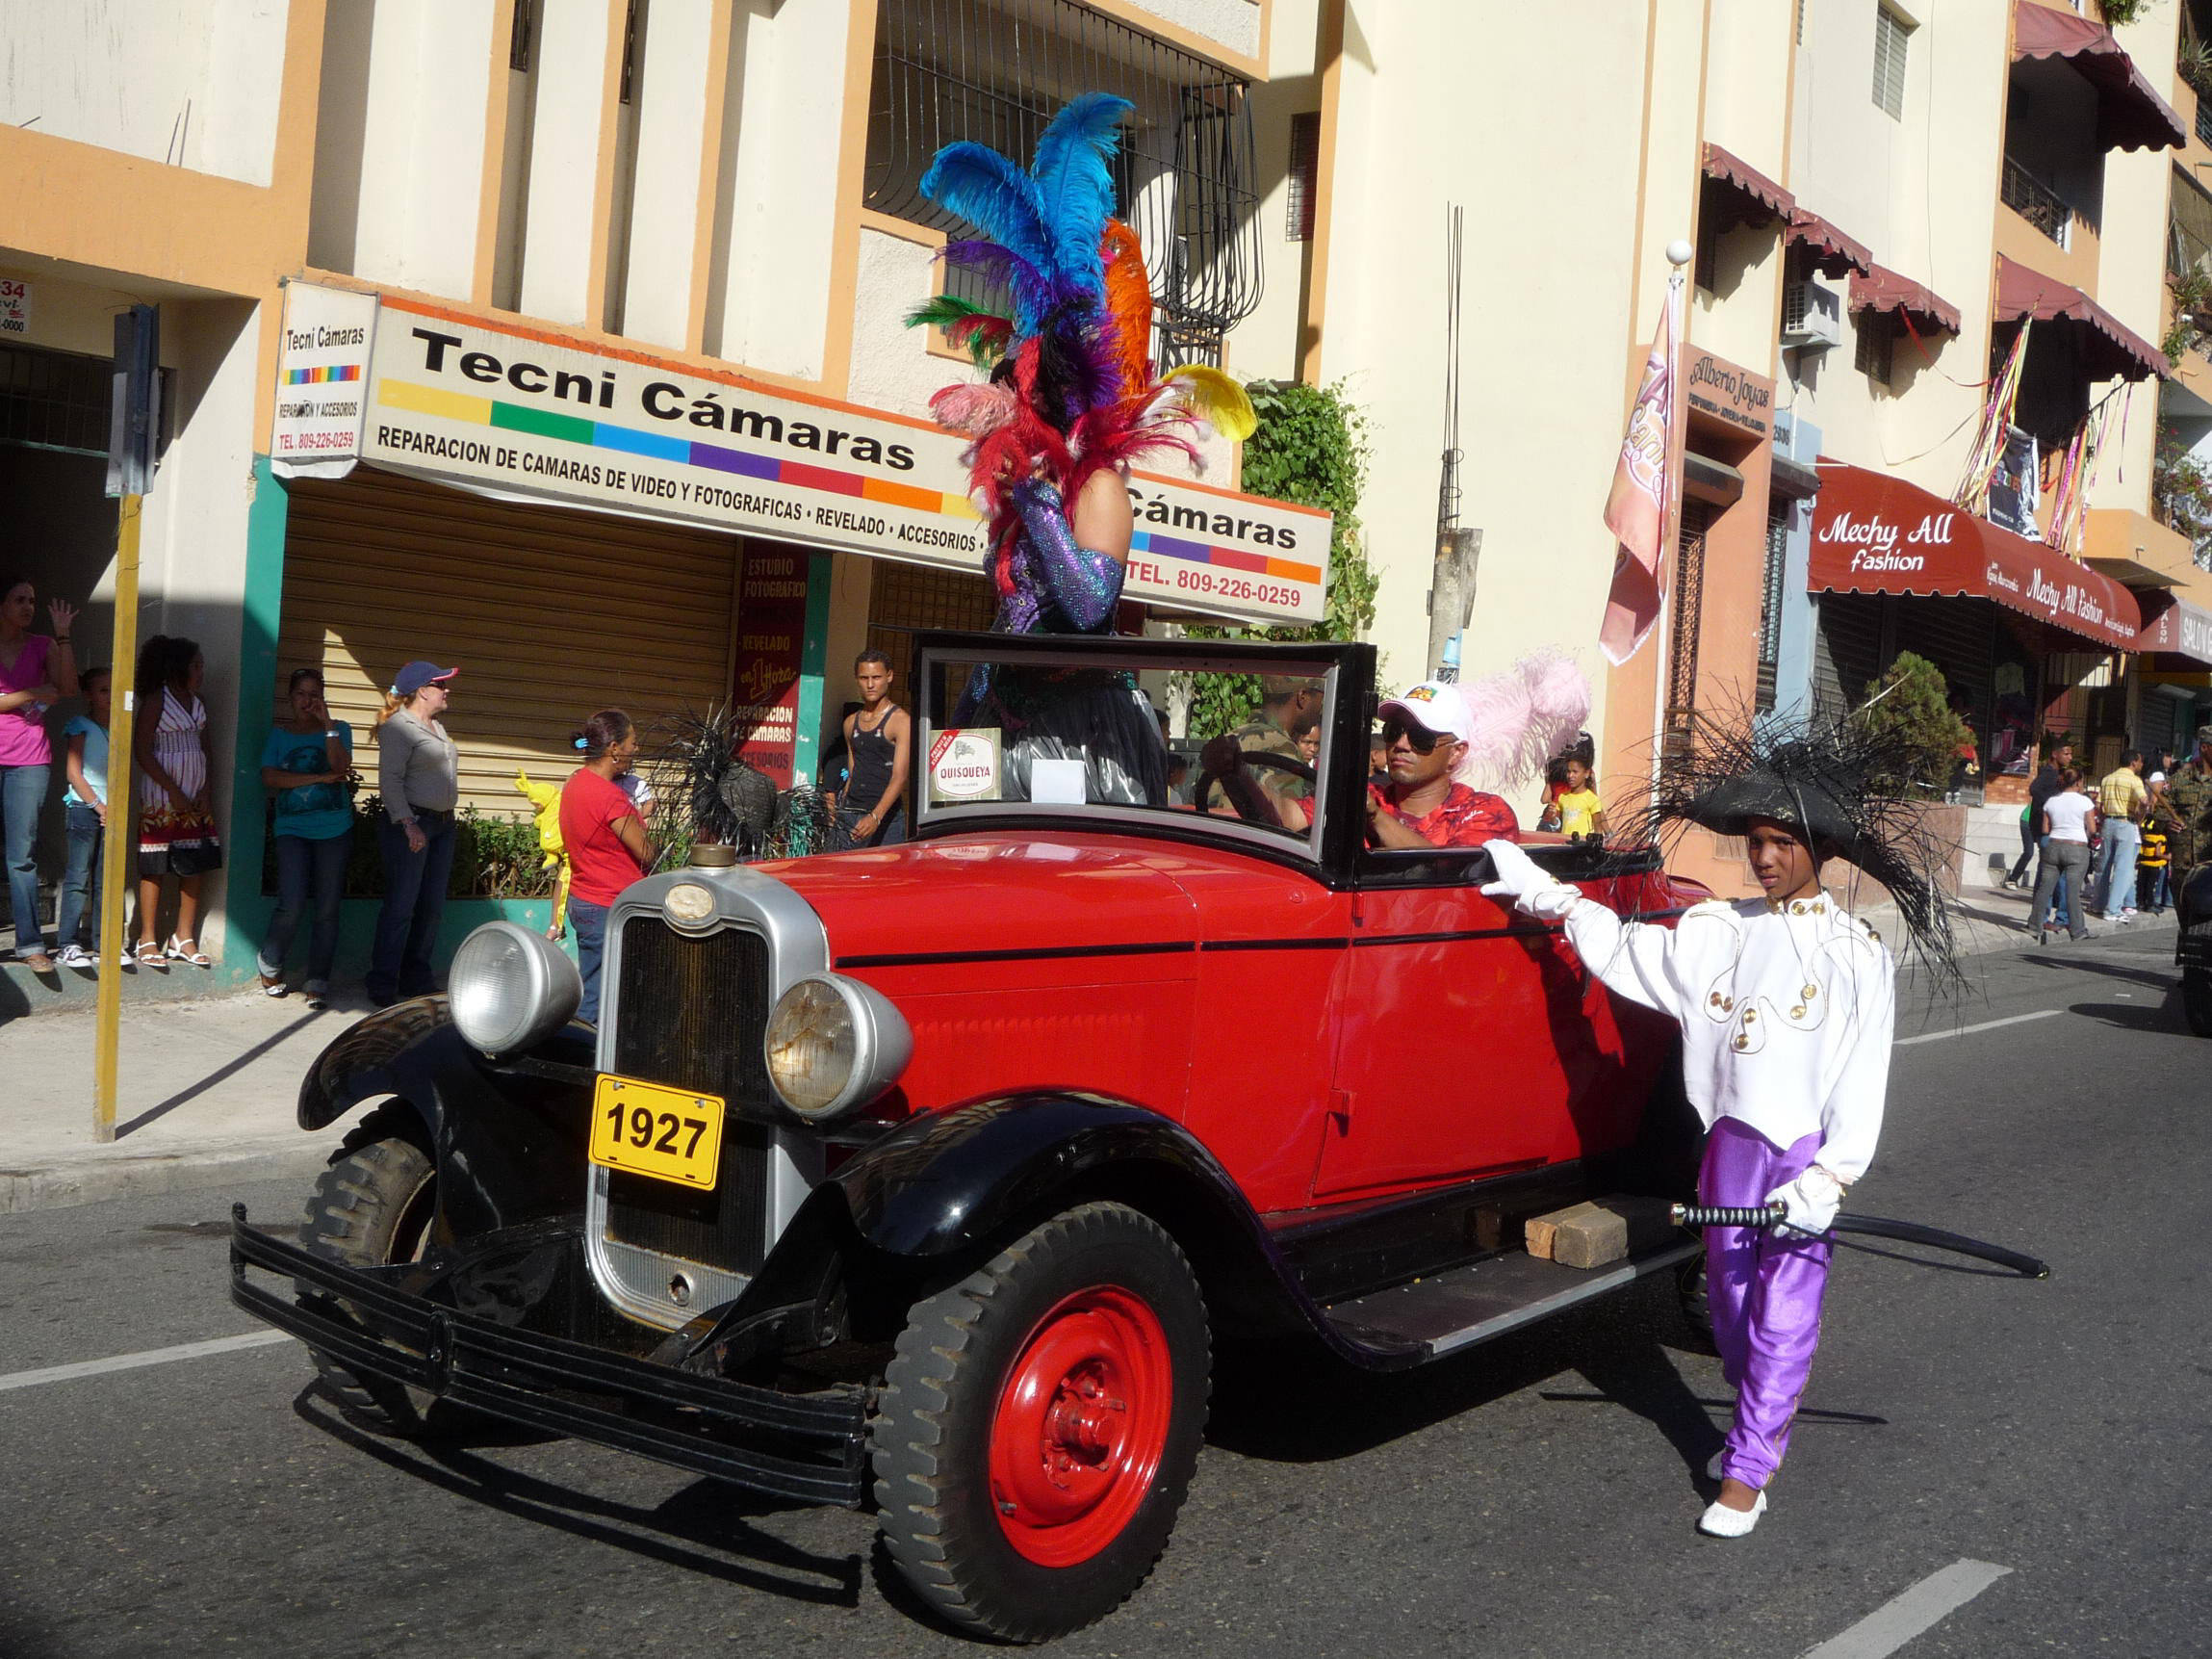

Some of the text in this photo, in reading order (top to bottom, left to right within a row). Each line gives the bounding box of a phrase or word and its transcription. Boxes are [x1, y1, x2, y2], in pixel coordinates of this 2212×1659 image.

[286, 325, 365, 351] Tecni Cámaras
[412, 326, 915, 471] Tecni Cámaras
[1689, 356, 1769, 411] Alberto Joyas
[316, 402, 322, 418] Y
[321, 402, 358, 417] ACCESORIOS
[298, 431, 354, 449] 809-226-0259
[377, 425, 976, 553] REPARACION DE CAMARAS DE VIDEO Y FOTOGRAFICAS REVELADO ACCESORIOS
[1818, 511, 1898, 552] Mechy
[1908, 513, 1955, 544] All
[748, 557, 794, 576] ESTUDIO
[1851, 548, 1924, 573] fashion
[745, 580, 807, 597] FOTOGRAFICO
[1127, 559, 1301, 608] TEL. 809-226-0259
[2025, 567, 2061, 616] Mechy
[2061, 583, 2077, 614] All
[2078, 587, 2103, 625] fashion
[742, 635, 790, 651] REVELADO
[750, 658, 766, 700] 1
[747, 725, 792, 743] CAMARAS
[606, 1102, 707, 1159] 1927
